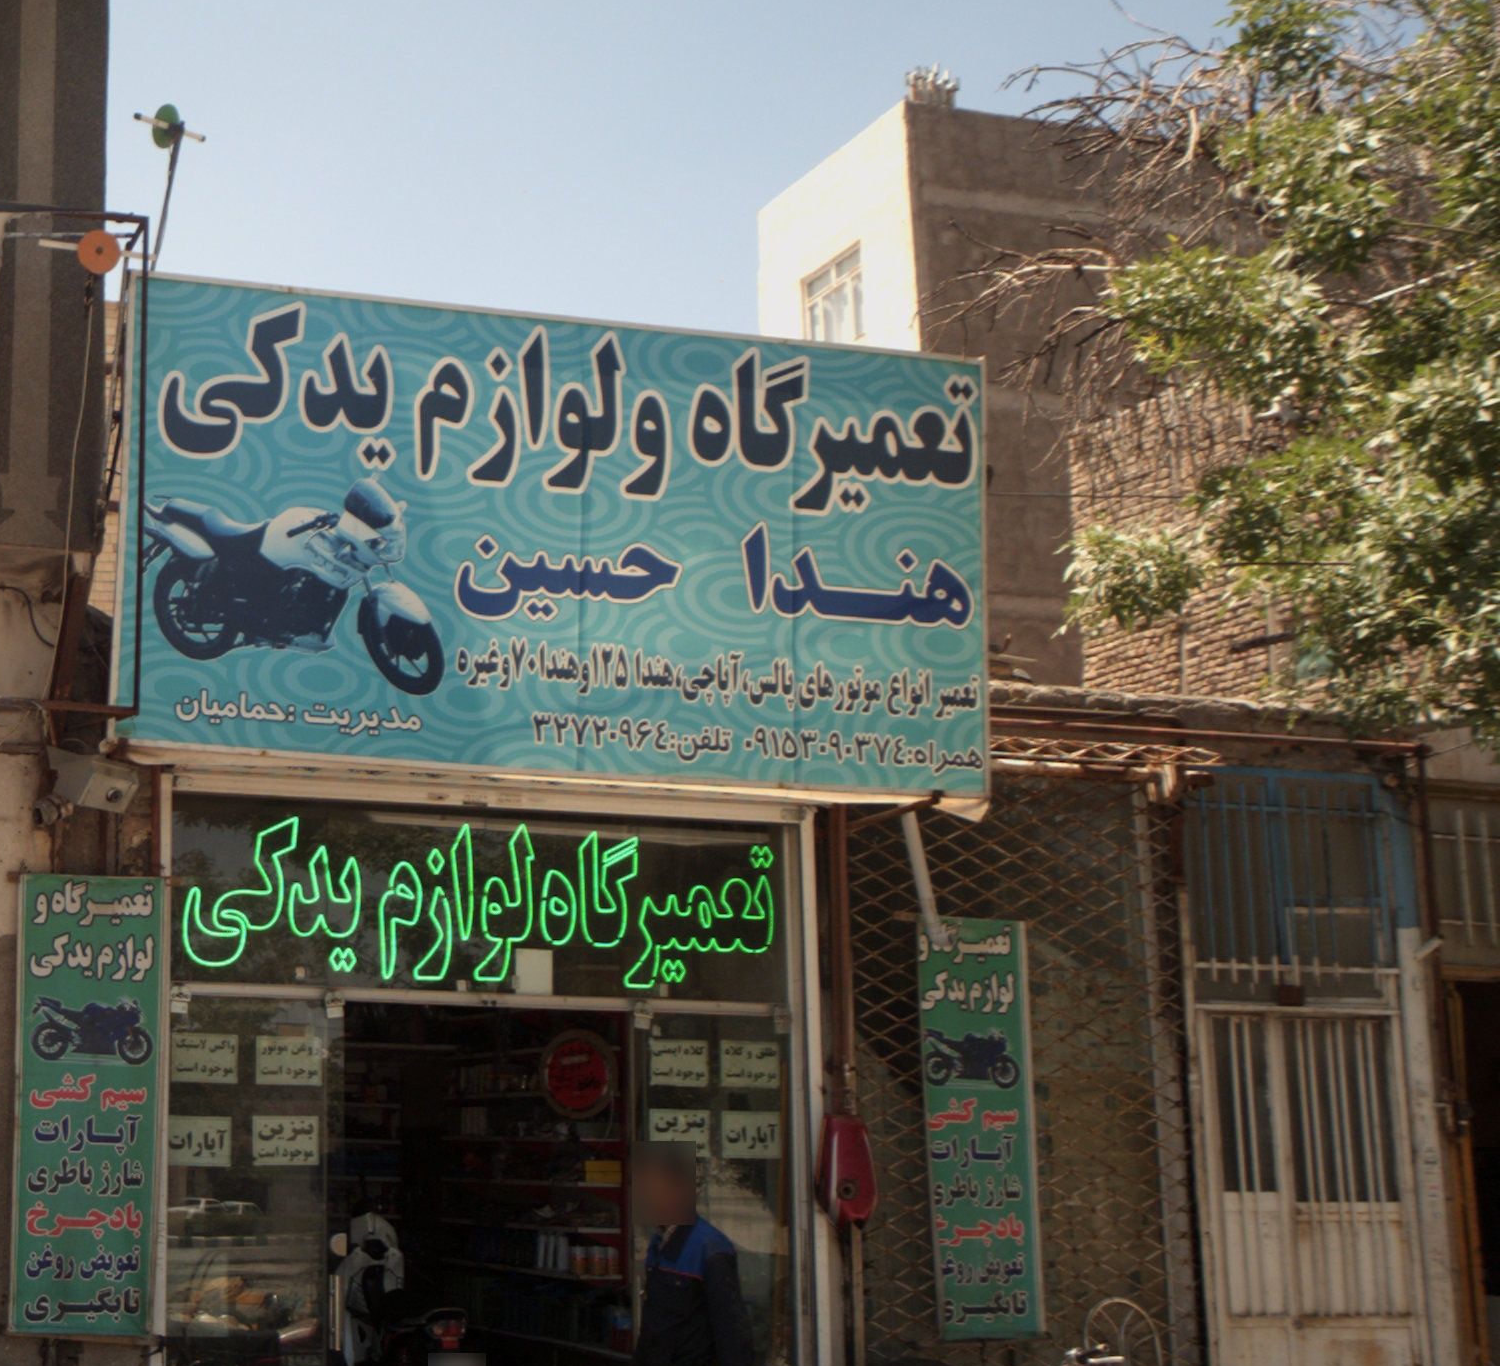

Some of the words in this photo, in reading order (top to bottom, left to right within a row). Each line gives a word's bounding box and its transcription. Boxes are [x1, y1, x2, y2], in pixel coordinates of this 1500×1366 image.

[159, 300, 397, 471] یدکی
[454, 533, 683, 623] حسین
[740, 521, 976, 631] هندا
[887, 667, 932, 716] انواع
[935, 676, 980, 718] تعمیر
[302, 701, 424, 737] مدیریت
[181, 815, 362, 974] یدکی
[378, 823, 536, 983] لوازم
[30, 932, 95, 978] یدکی
[96, 935, 155, 982] لوازم
[969, 970, 1016, 1015] لوازم
[30, 1073, 97, 1110] کشی
[101, 1085, 148, 1112] سیم
[33, 1114, 142, 1156] آپارات
[258, 1120, 315, 1142] بنزین
[654, 1112, 707, 1134] بنزین
[725, 1123, 778, 1150] آپارات
[982, 1108, 1020, 1132] سیم
[169, 1129, 228, 1158] آپارات
[27, 1157, 94, 1194] باطری
[97, 1161, 145, 1196] شارژ
[984, 1175, 1023, 1209] شارژ
[25, 1242, 75, 1280] روغن
[79, 1244, 141, 1281] تعویض
